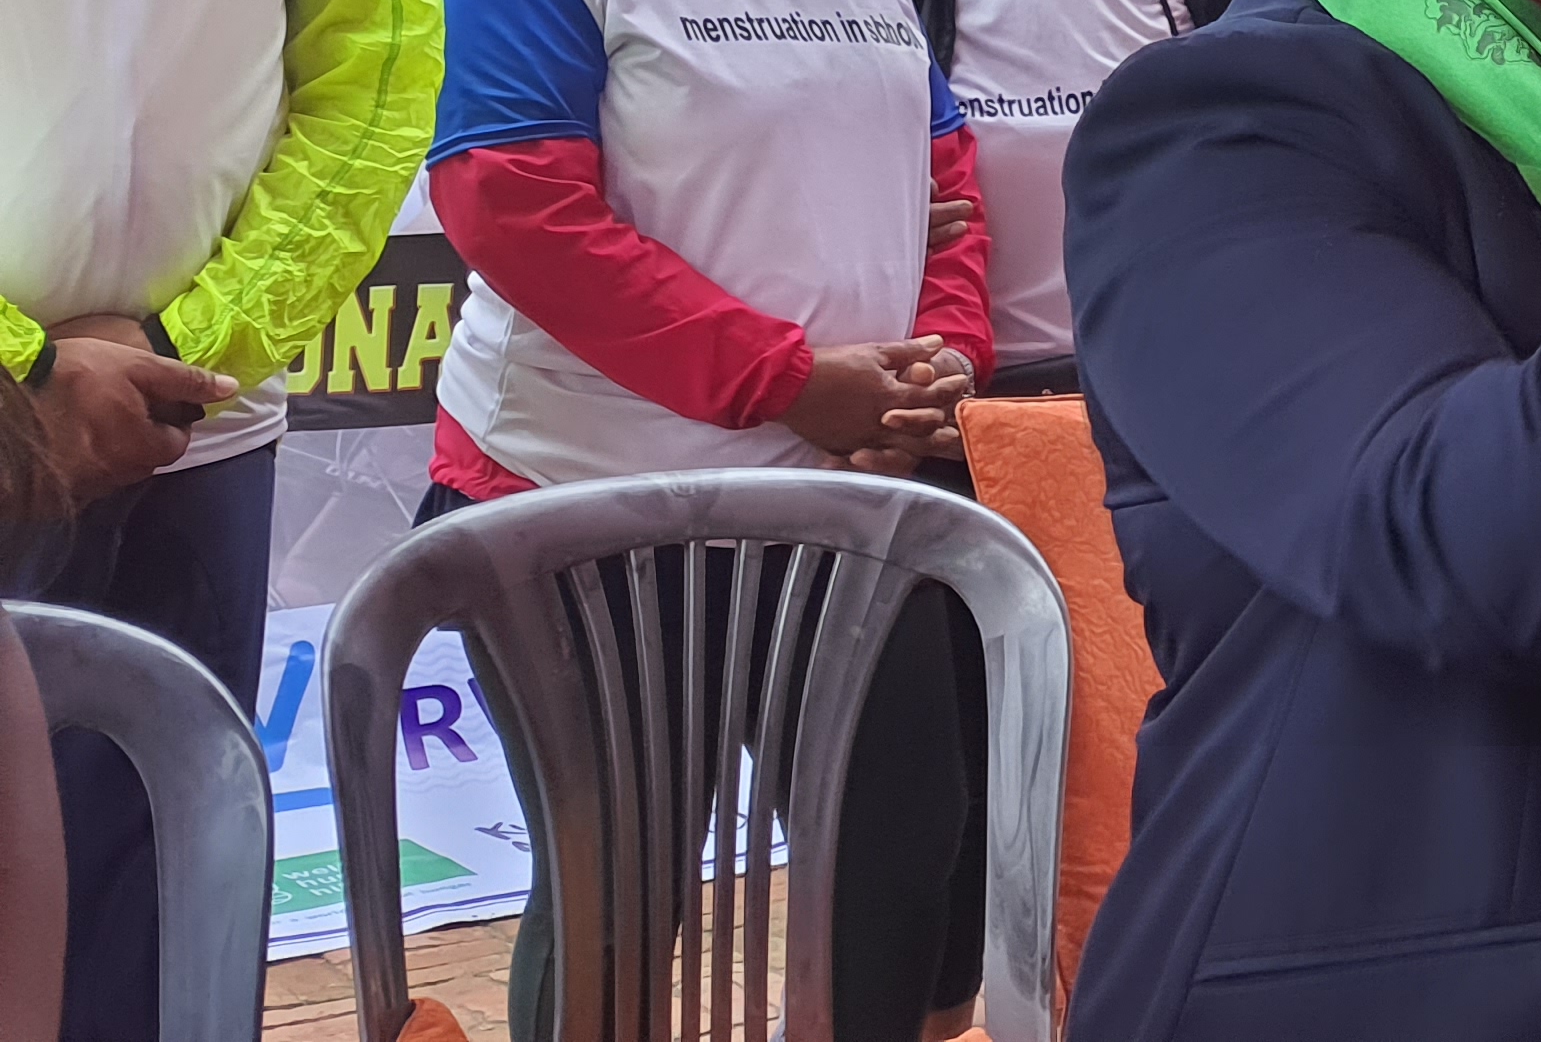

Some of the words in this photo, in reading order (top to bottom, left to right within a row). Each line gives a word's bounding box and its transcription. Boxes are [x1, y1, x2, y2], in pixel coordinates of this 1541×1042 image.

[680, 11, 841, 44] menstruation
[834, 11, 869, 44] in
[287, 283, 456, 396] NA
